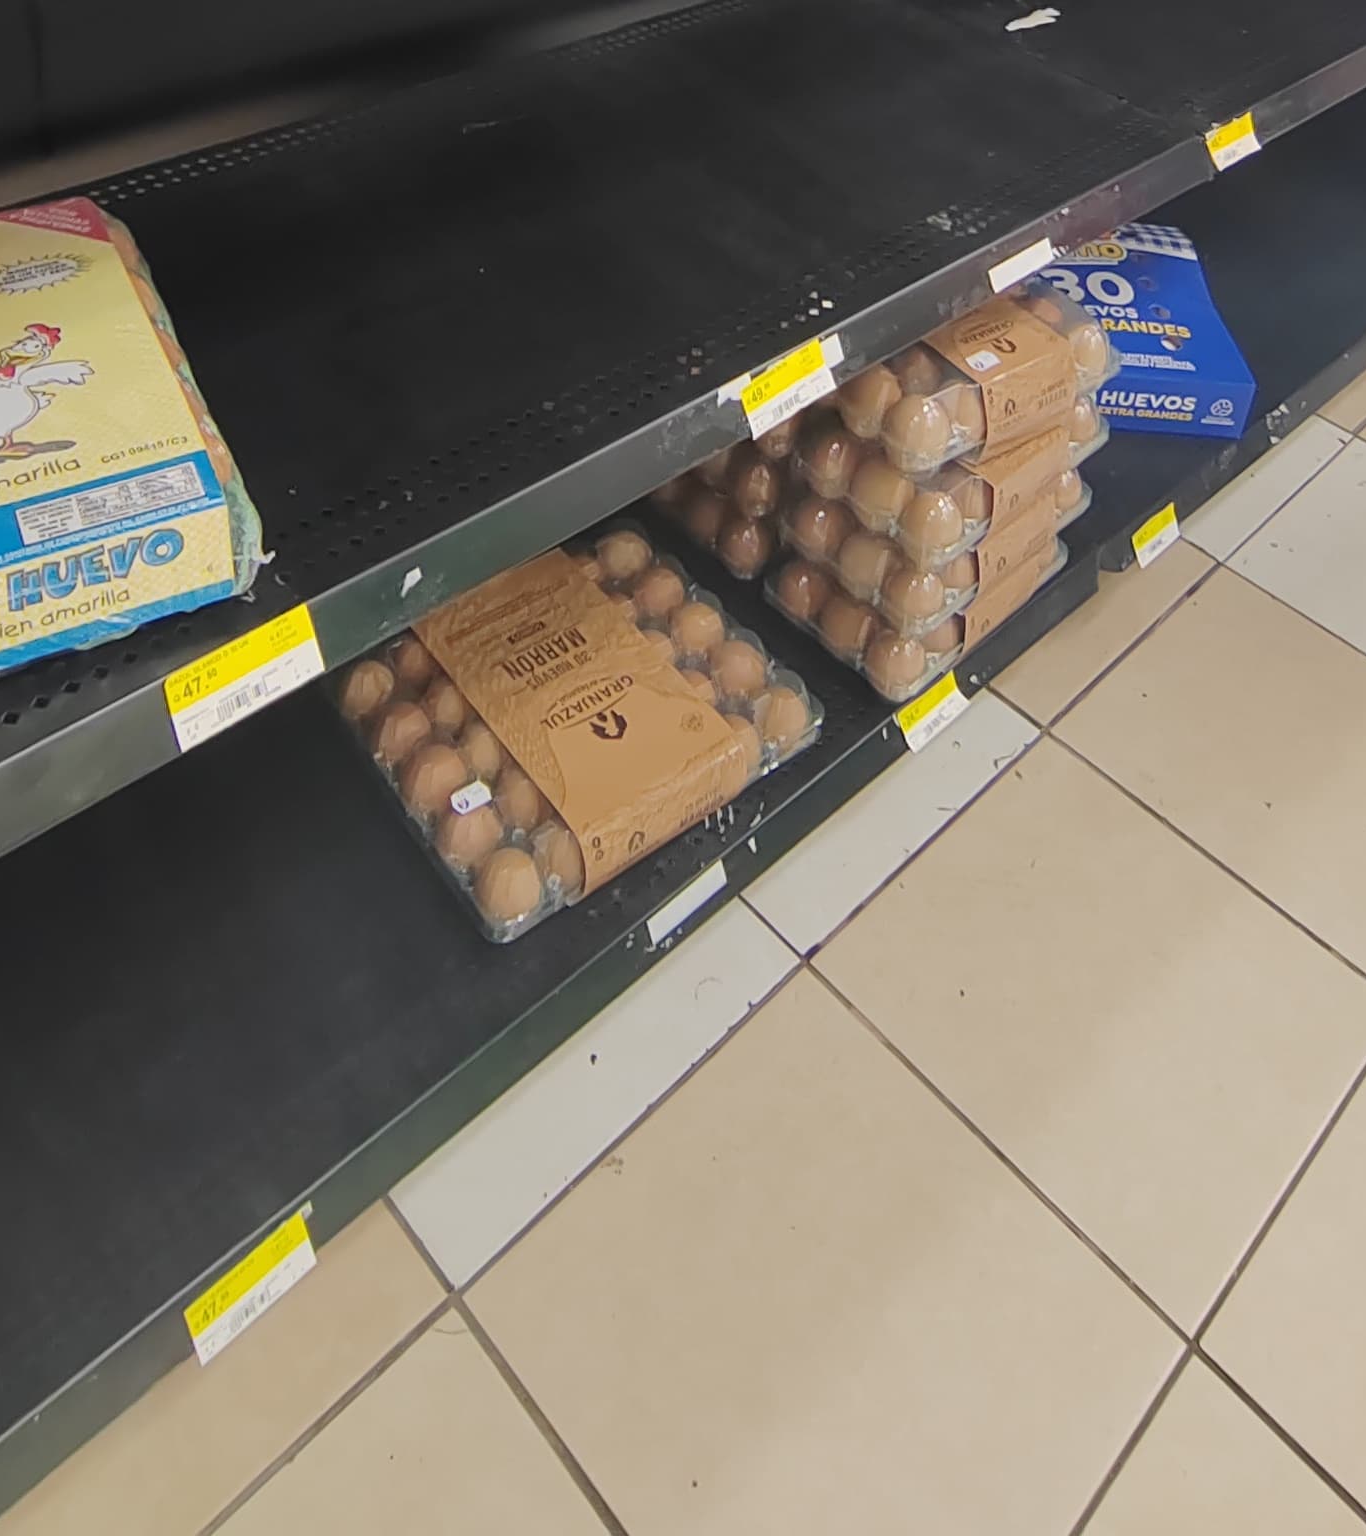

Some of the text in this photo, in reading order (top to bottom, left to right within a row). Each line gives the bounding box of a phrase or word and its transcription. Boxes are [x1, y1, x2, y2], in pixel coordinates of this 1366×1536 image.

[1038, 268, 1135, 306] 30
[1085, 305, 1139, 319] EVOS
[1101, 317, 1191, 339] RANDES
[1099, 389, 1197, 412] HUEVOS
[1136, 408, 1194, 422] GRANDES
[8, 527, 185, 613] HUEVO
[40, 586, 130, 628] amarilla
[539, 674, 634, 730] GRANJAZUL
